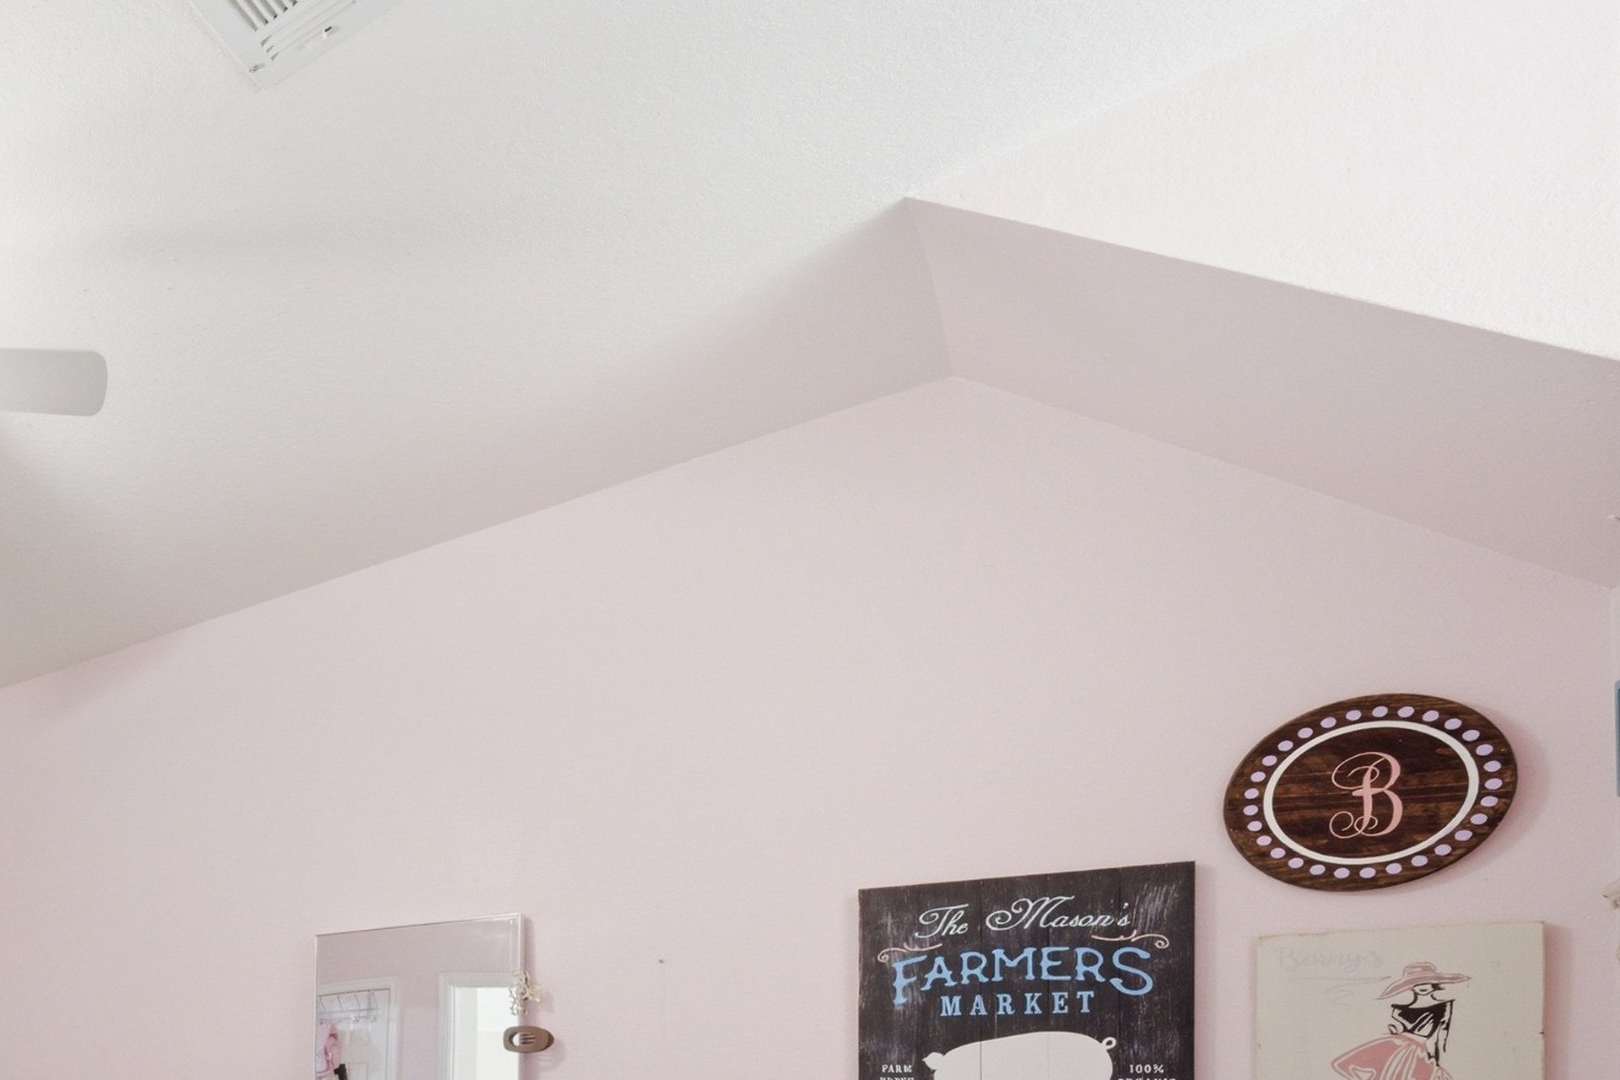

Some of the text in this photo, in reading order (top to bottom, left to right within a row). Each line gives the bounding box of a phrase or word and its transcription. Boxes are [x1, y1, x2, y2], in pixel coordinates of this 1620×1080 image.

[1329, 751, 1404, 839] B
[914, 895, 1131, 938] The Mason's
[892, 946, 1154, 1007] FARMERS
[940, 990, 1095, 1016] MARKET
[1129, 1063, 1165, 1074] 100%
